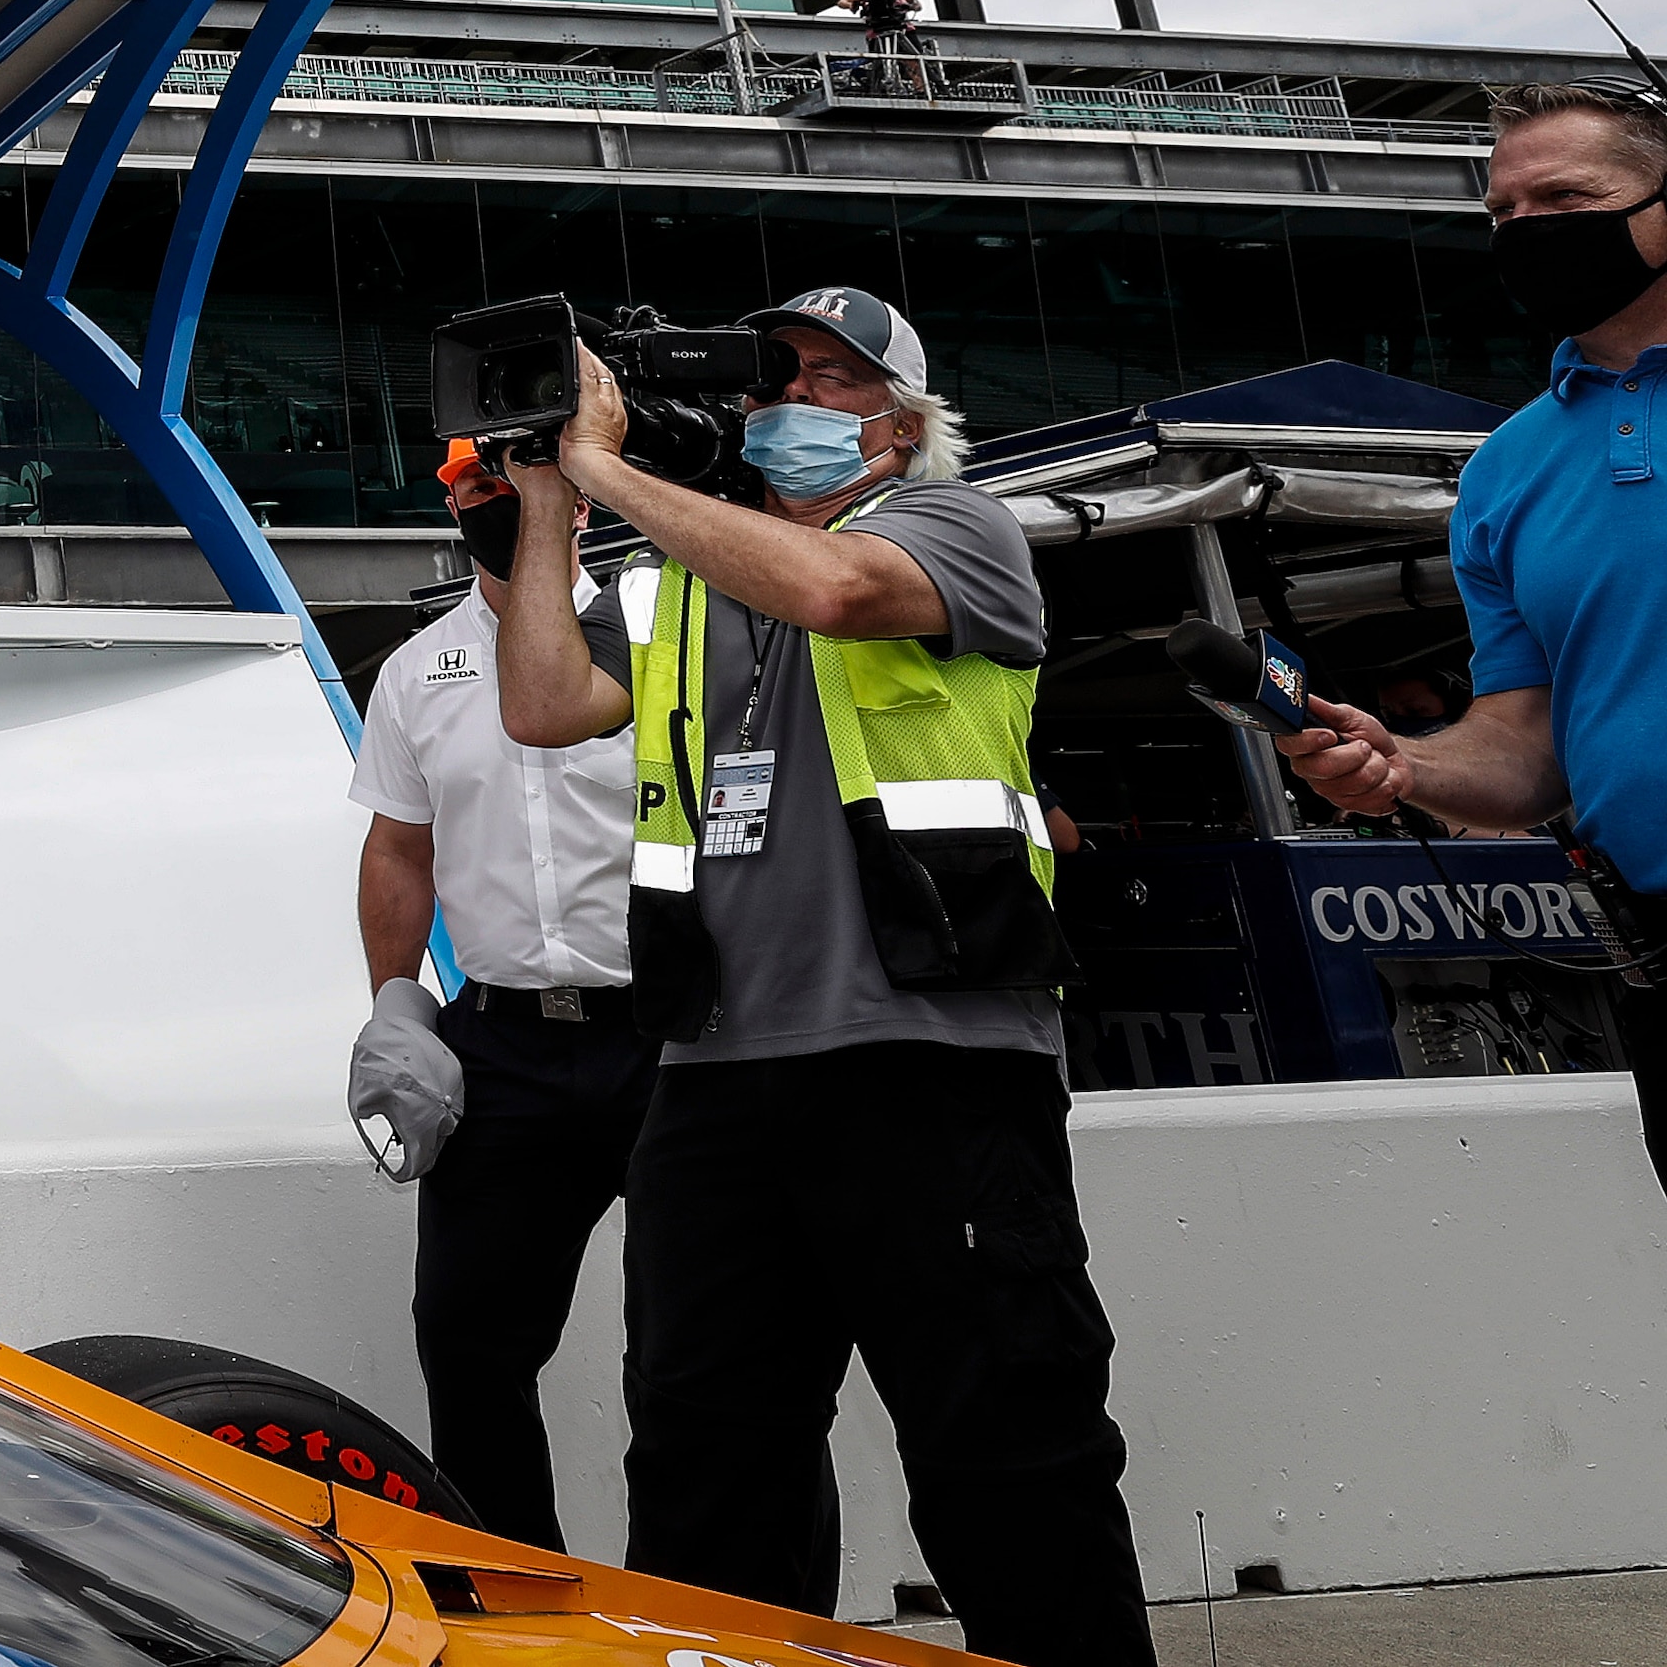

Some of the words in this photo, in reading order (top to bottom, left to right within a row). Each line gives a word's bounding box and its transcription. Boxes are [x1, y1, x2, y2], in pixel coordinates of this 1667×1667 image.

[671, 350, 708, 359] SONY
[426, 669, 480, 682] HONDA
[1310, 881, 1586, 944] COSWOR
